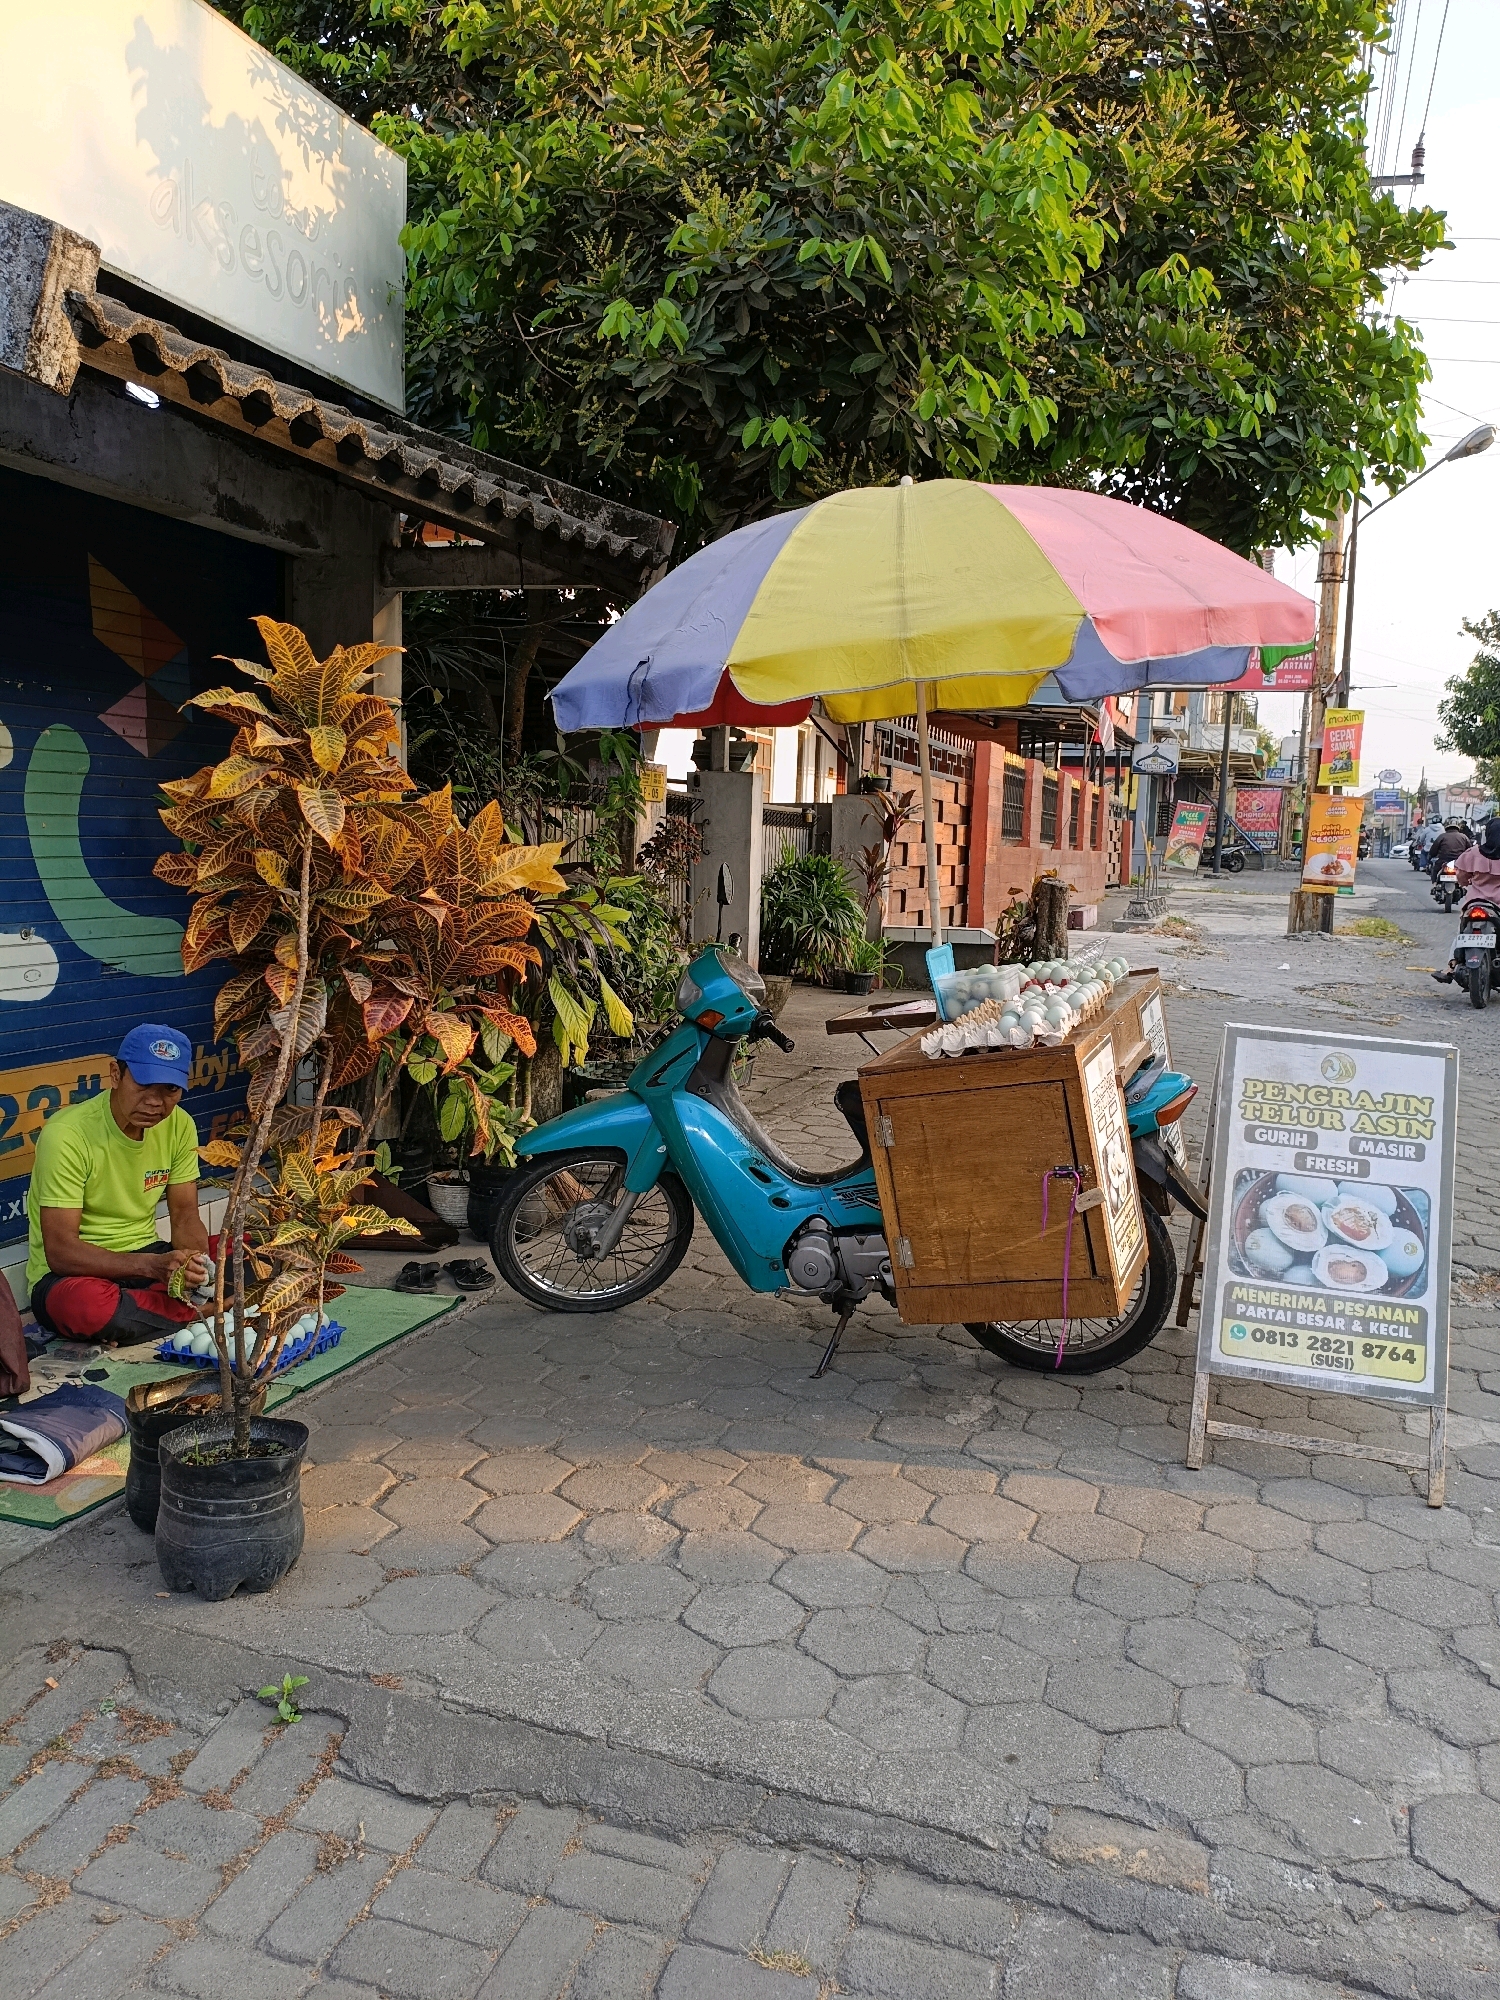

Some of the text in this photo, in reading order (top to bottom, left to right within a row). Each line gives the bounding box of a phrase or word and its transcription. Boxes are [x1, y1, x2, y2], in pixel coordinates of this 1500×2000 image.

[1328, 712, 1360, 724] maxim
[1329, 729, 1355, 742] CEPAT
[1330, 741, 1356, 751] SAMPAI
[651, 787, 659, 798] 05
[1243, 1079, 1433, 1116] PENGRAJIN
[1239, 1101, 1435, 1139] TELUR ASIN
[1254, 1128, 1417, 1159] GURIH MASIR
[1305, 1156, 1359, 1175] FRESH
[1232, 1286, 1419, 1324] MENERIMA PESANAN
[1236, 1303, 1413, 1339] PARTAI BESAR & KECIL
[1251, 1327, 1417, 1364] 0813 2821 8764
[1310, 1352, 1355, 1371] (SUSI)
